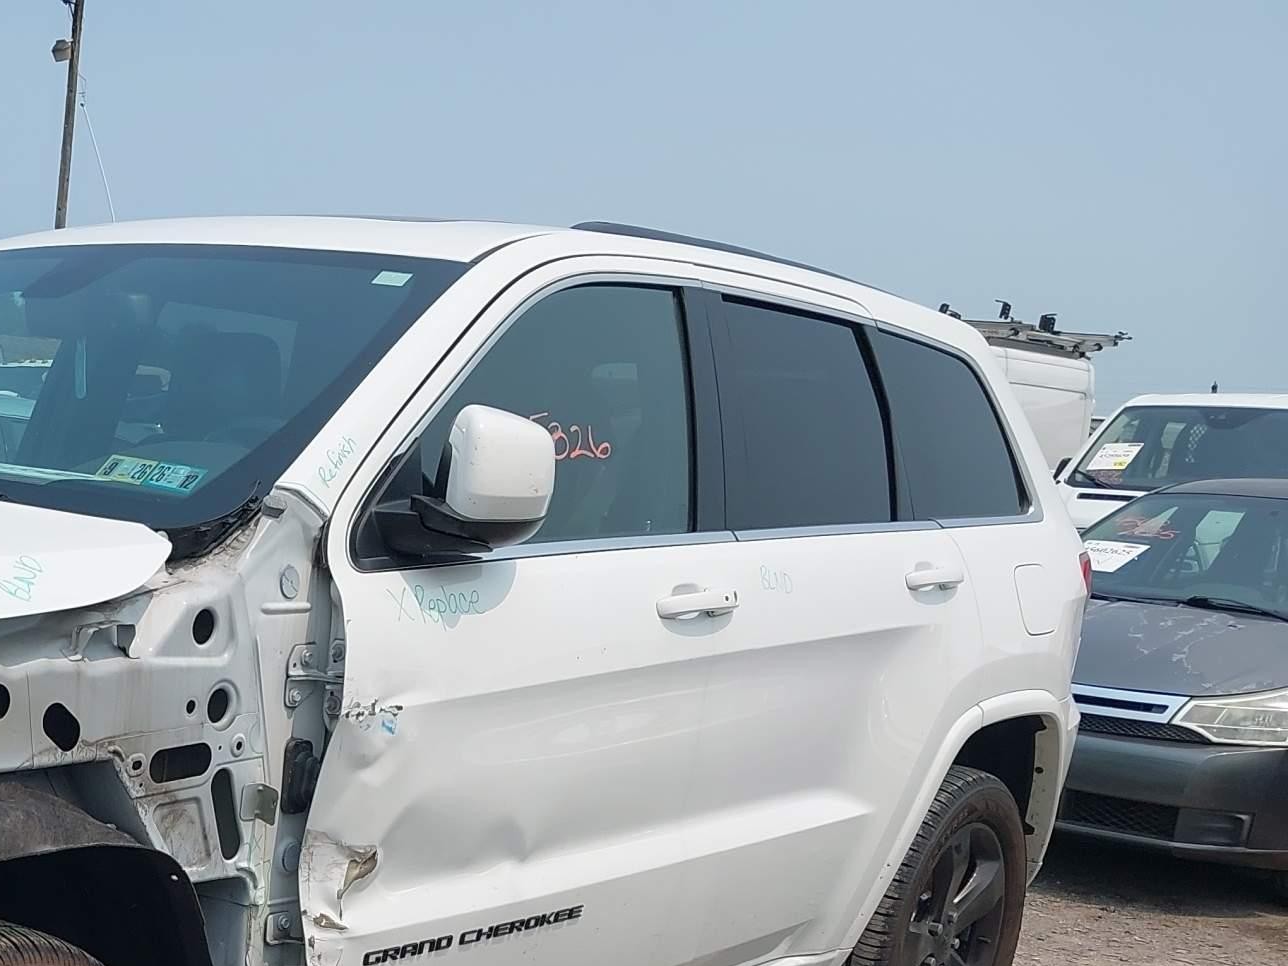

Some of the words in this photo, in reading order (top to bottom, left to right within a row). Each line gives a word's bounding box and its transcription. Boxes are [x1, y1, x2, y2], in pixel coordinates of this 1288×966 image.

[529, 411, 611, 460] 326
[131, 463, 152, 481] 26
[151, 465, 172, 482] 26
[178, 474, 199, 490] 12
[385, 586, 415, 621] X
[413, 584, 485, 632] Replace
[362, 934, 453, 966] GRAND
[458, 904, 584, 946] CHEROKEE
